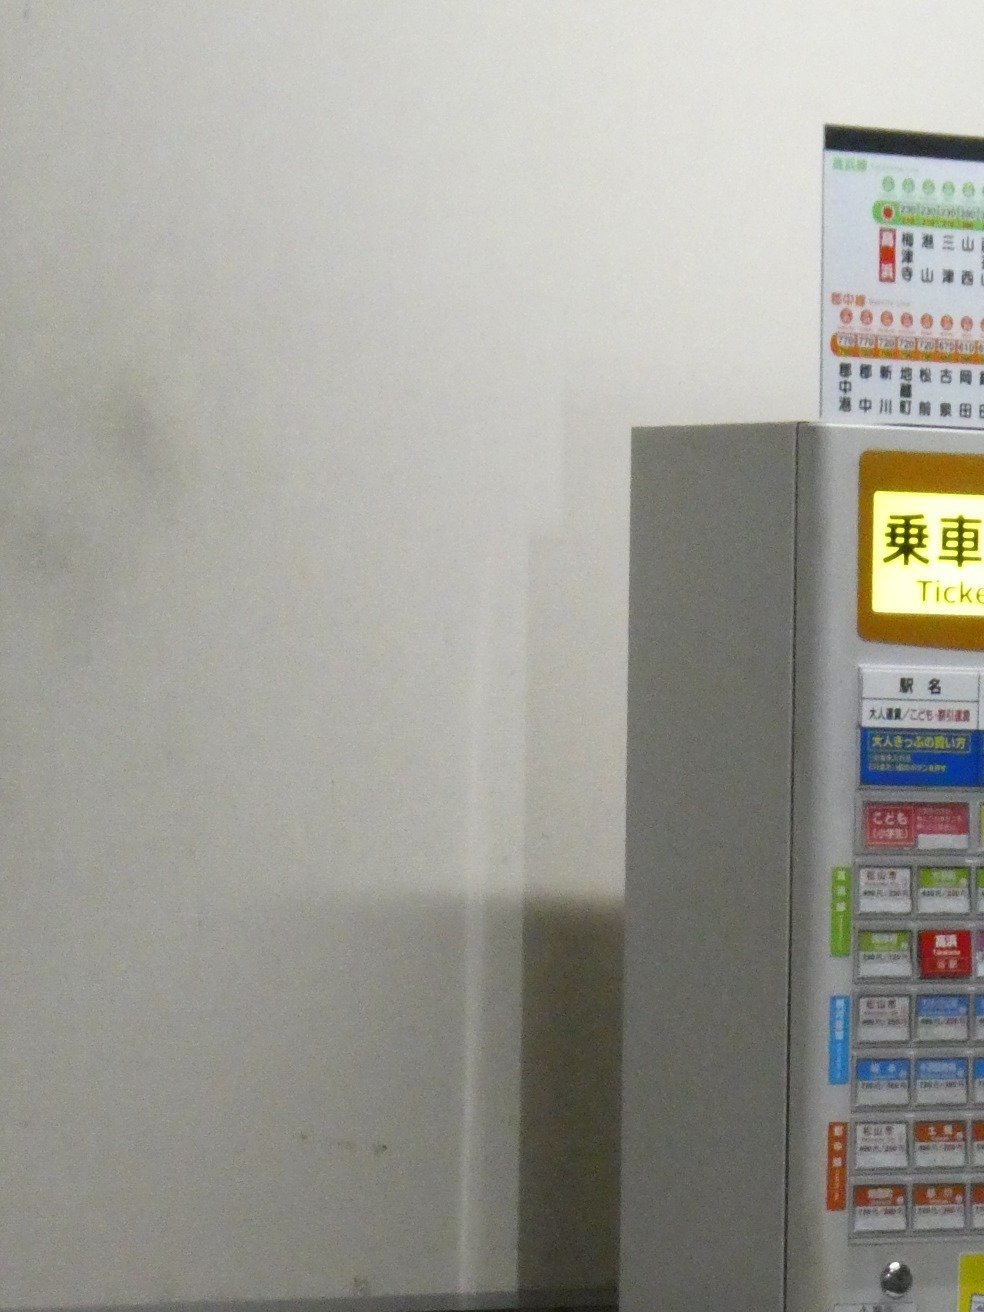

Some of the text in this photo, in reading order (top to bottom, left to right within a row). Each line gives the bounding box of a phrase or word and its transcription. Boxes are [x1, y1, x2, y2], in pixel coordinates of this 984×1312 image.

[900, 677, 943, 695] 駅名
[872, 811, 909, 825] こども
